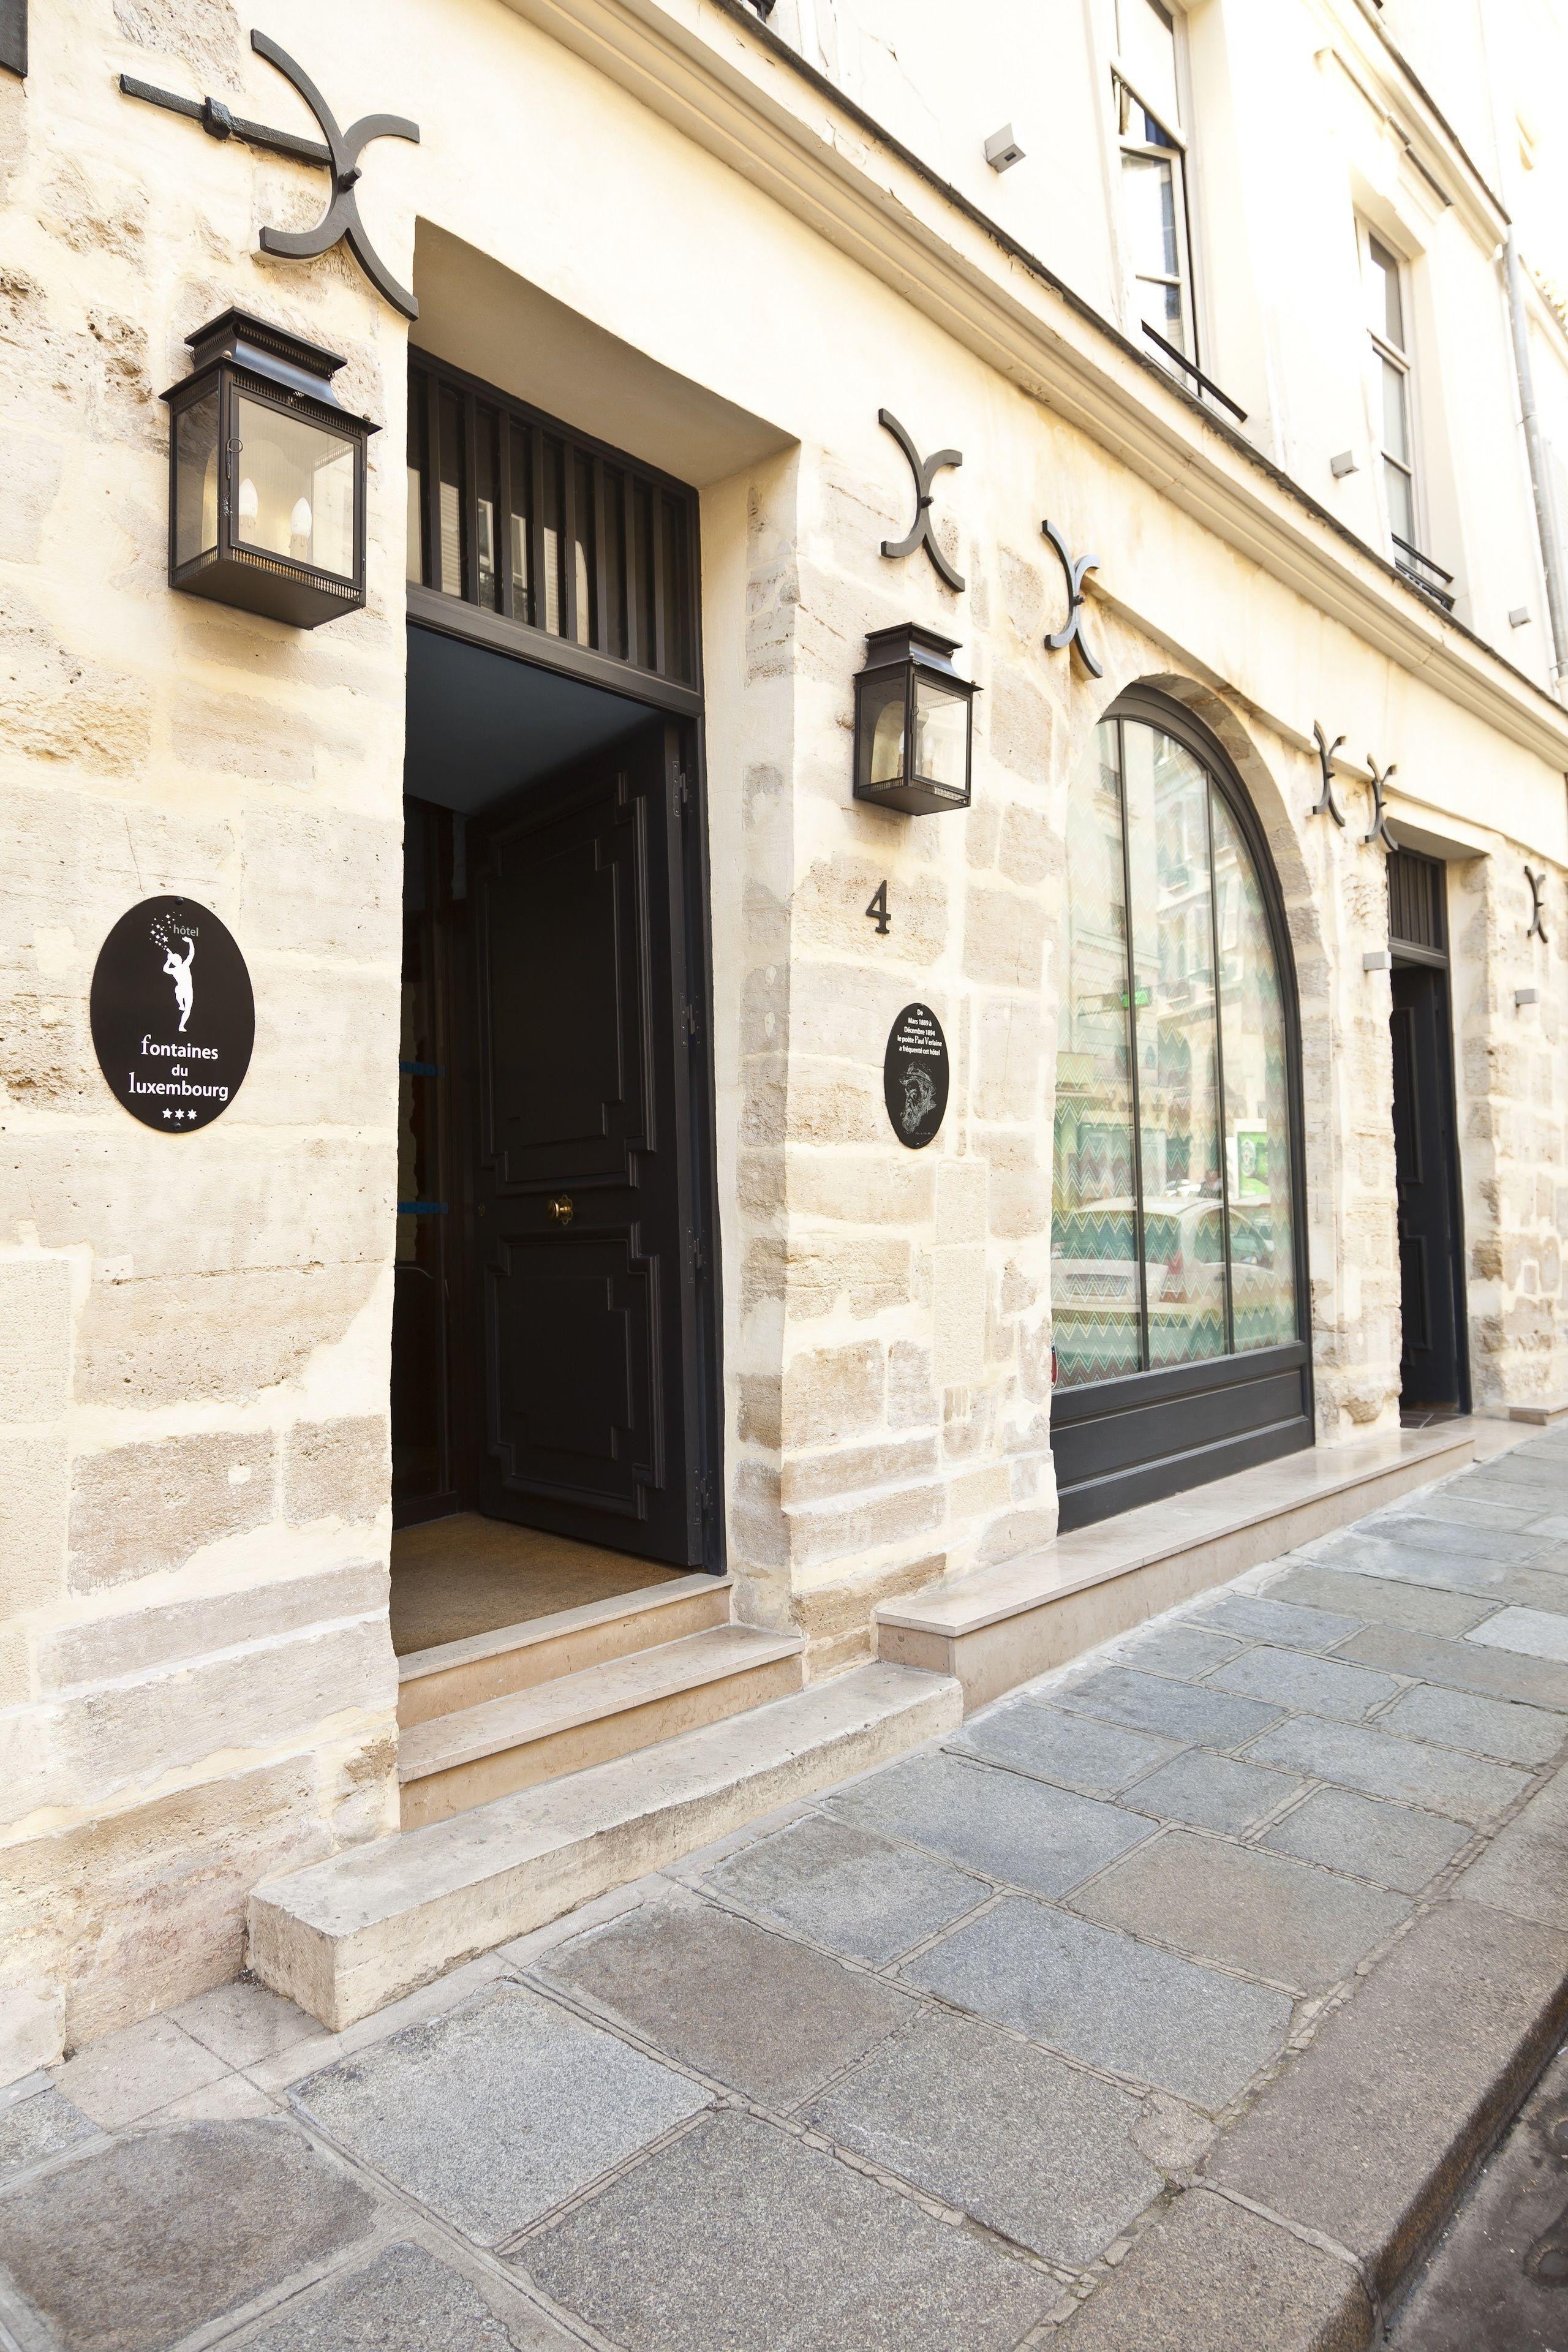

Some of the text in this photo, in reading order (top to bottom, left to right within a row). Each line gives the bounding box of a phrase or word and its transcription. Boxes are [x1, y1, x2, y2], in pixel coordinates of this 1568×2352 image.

[865, 880, 891, 934] 4
[173, 924, 199, 937] hôtel
[904, 1026, 925, 1035] Décembre
[140, 1034, 219, 1060] fontaines
[914, 1035, 924, 1044] Paul
[924, 1036, 943, 1047] Verlaine
[902, 1045, 922, 1054] fréquenté
[172, 1064, 189, 1077] du
[128, 1071, 229, 1101] luxembourg
